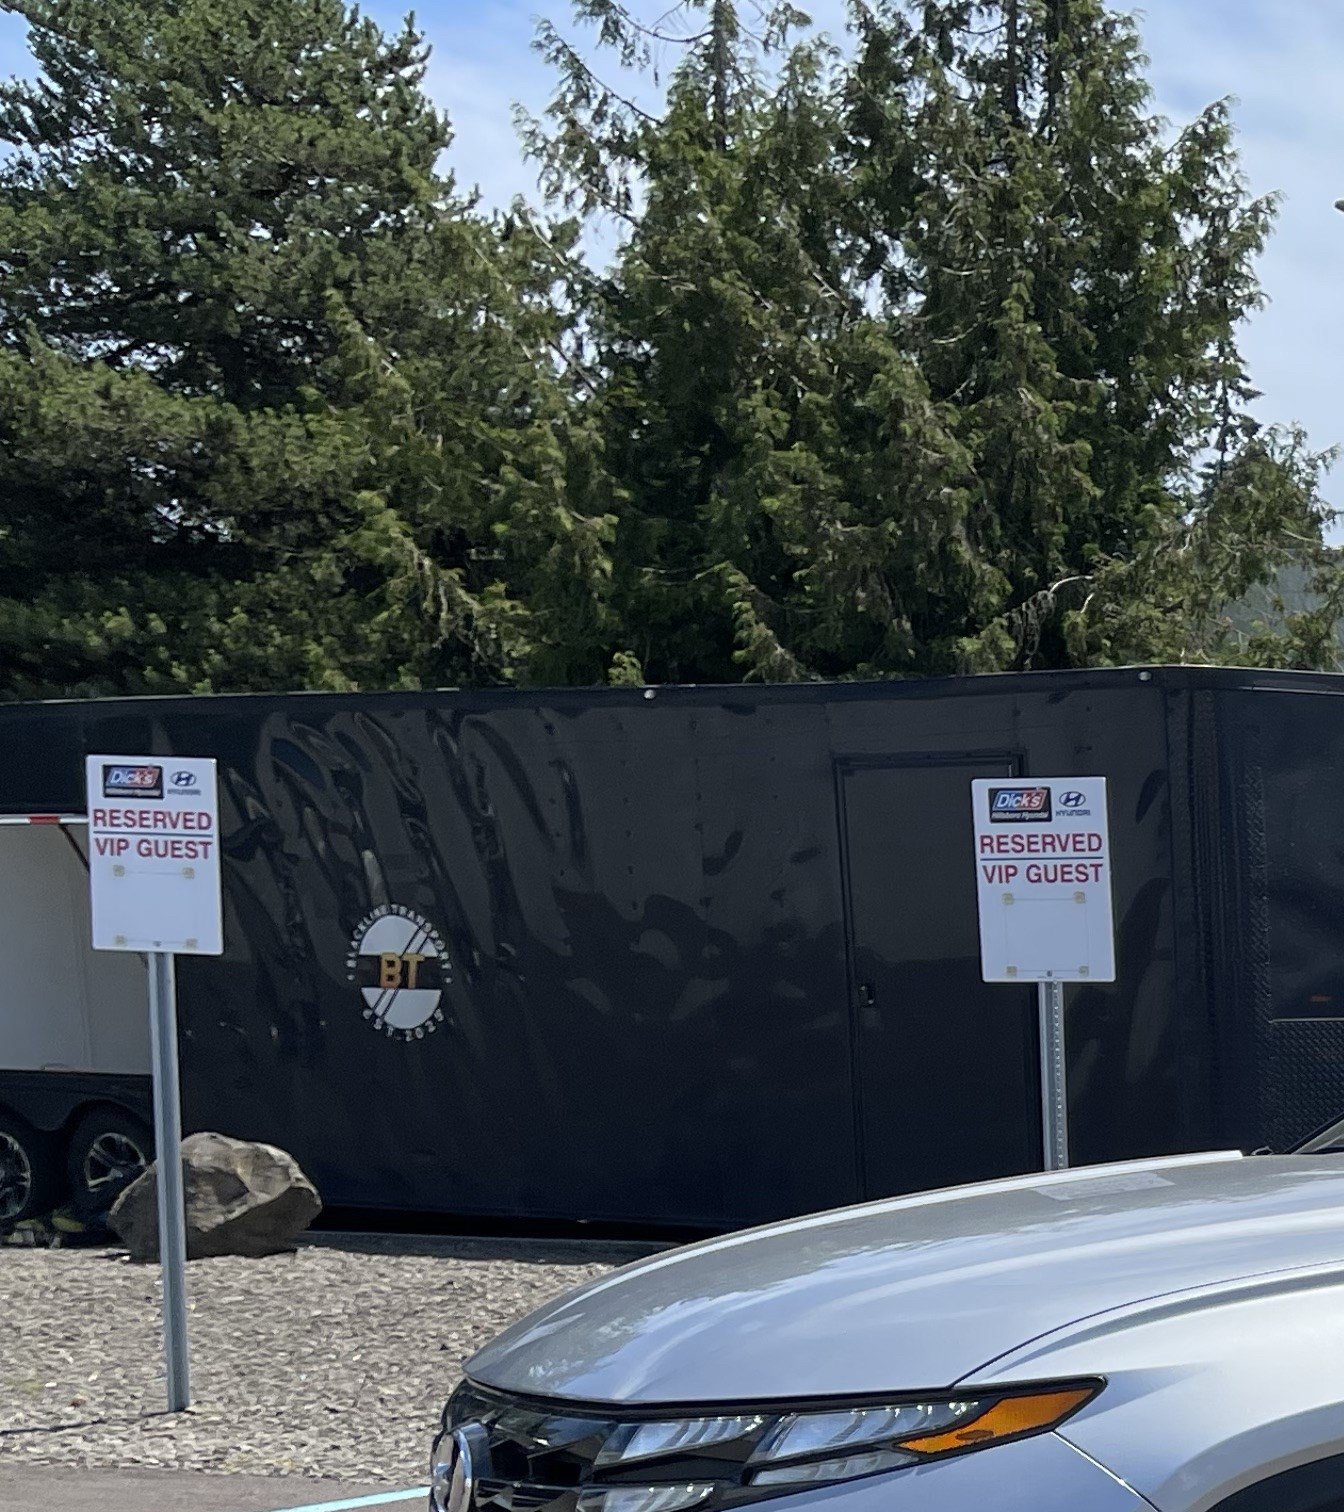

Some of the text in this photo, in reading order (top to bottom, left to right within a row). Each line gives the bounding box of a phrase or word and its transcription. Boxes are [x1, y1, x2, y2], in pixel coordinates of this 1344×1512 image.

[996, 791, 1041, 810] Dick's
[93, 808, 212, 831] RESERVED
[94, 837, 213, 860] VIP GUEST
[979, 832, 1103, 854] RESERVED
[982, 863, 1104, 884] VIP GUEST
[380, 951, 426, 990] BT
